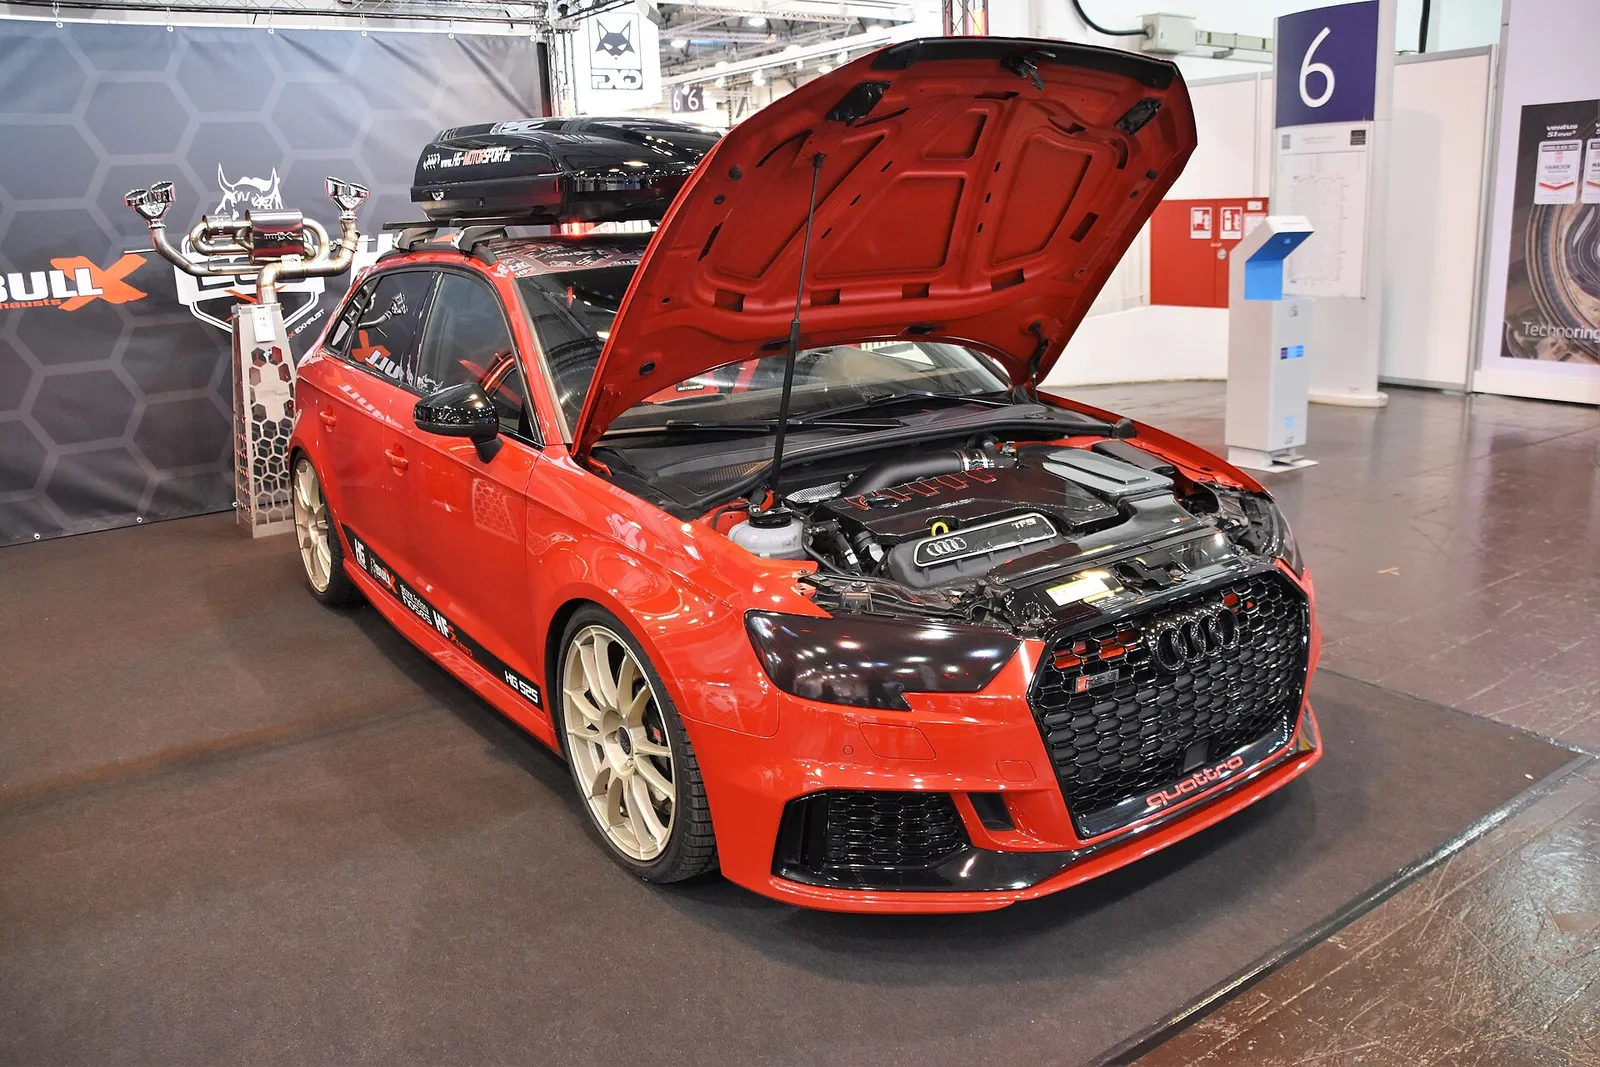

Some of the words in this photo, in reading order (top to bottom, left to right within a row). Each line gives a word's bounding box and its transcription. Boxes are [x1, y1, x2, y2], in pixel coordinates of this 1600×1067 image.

[1299, 26, 1336, 109] 6
[672, 89, 681, 113] 6
[687, 88, 700, 111] 6
[294, 308, 325, 335] EXHAUST
[518, 680, 539, 704] 525
[1145, 755, 1245, 808] quattro
